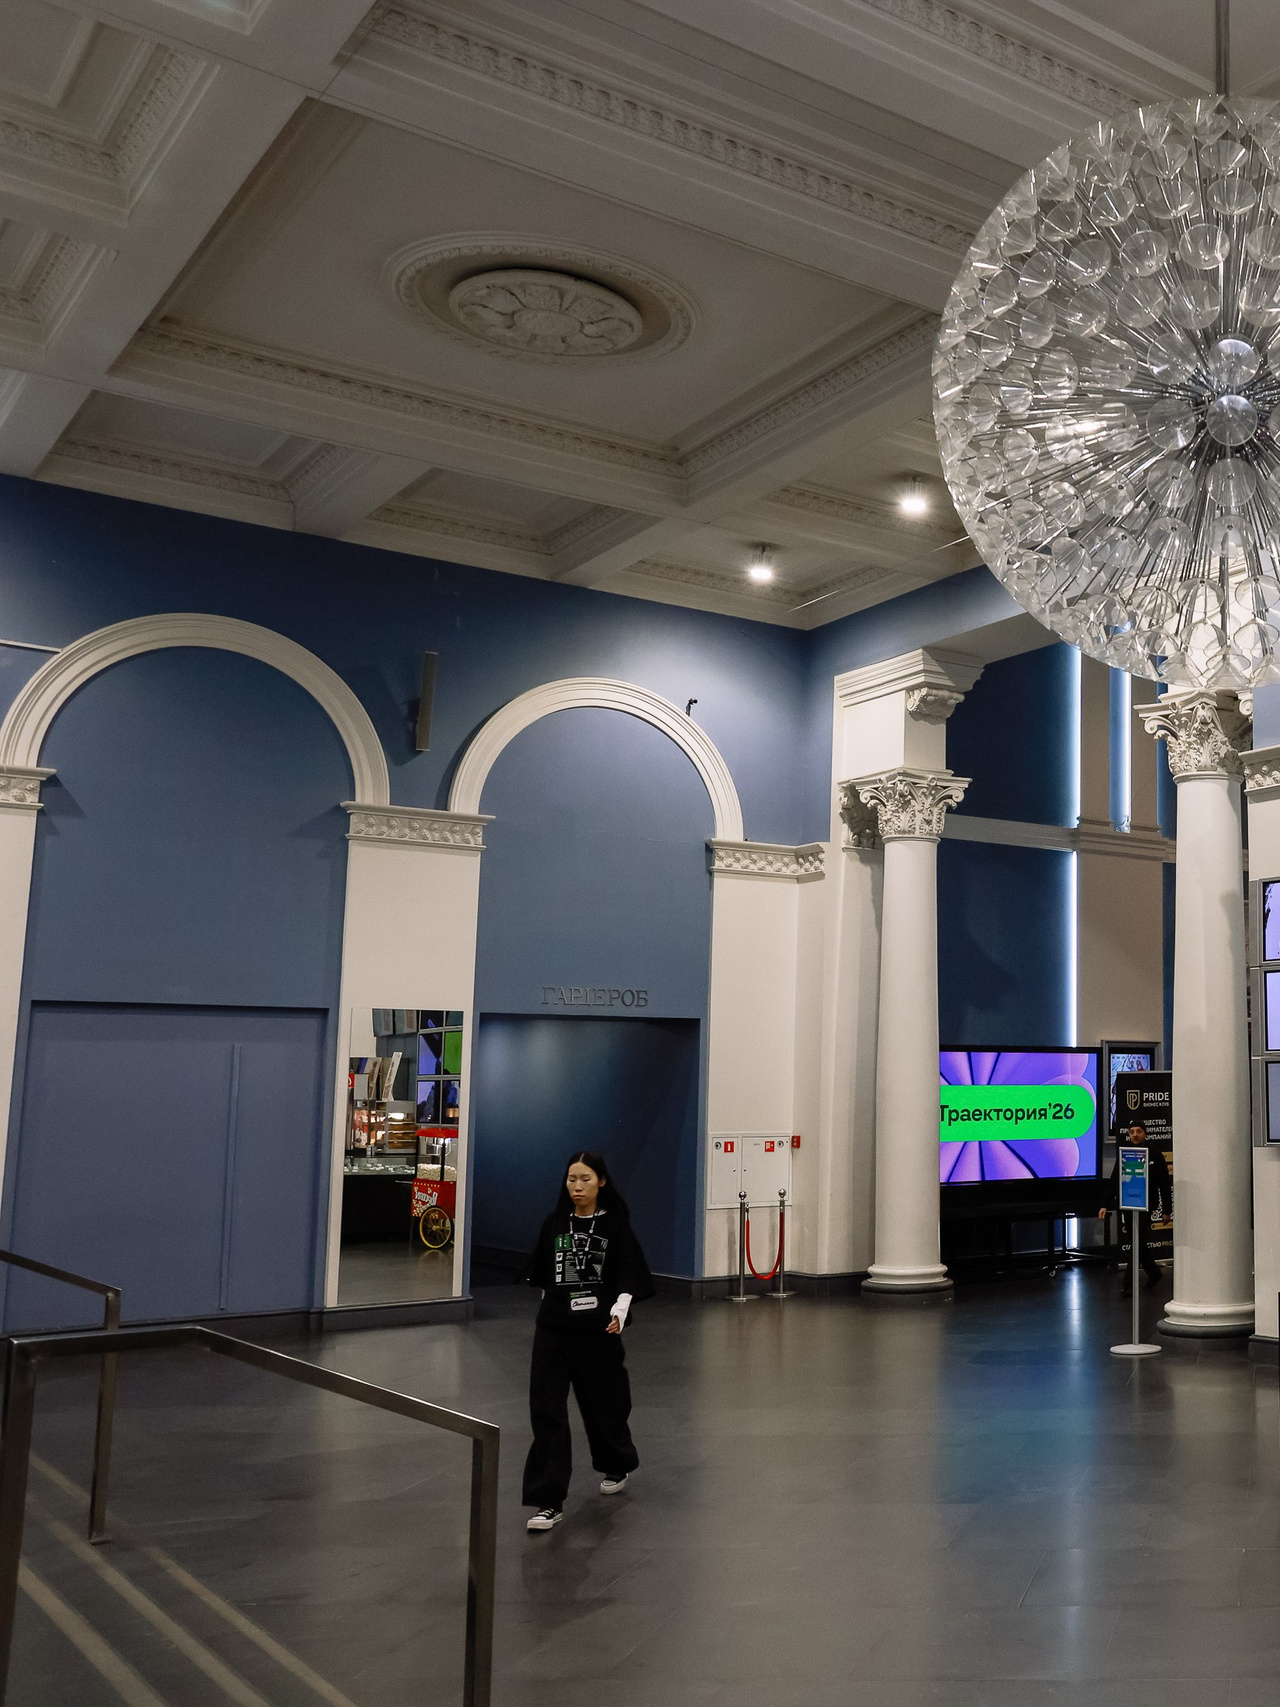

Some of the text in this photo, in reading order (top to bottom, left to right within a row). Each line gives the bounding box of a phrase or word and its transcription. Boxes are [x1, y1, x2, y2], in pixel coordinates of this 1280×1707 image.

[541, 986, 649, 1007] ГАРДЕРОБ
[1143, 1092, 1170, 1101] PRIDE
[940, 1102, 1075, 1127] Траектория'26
